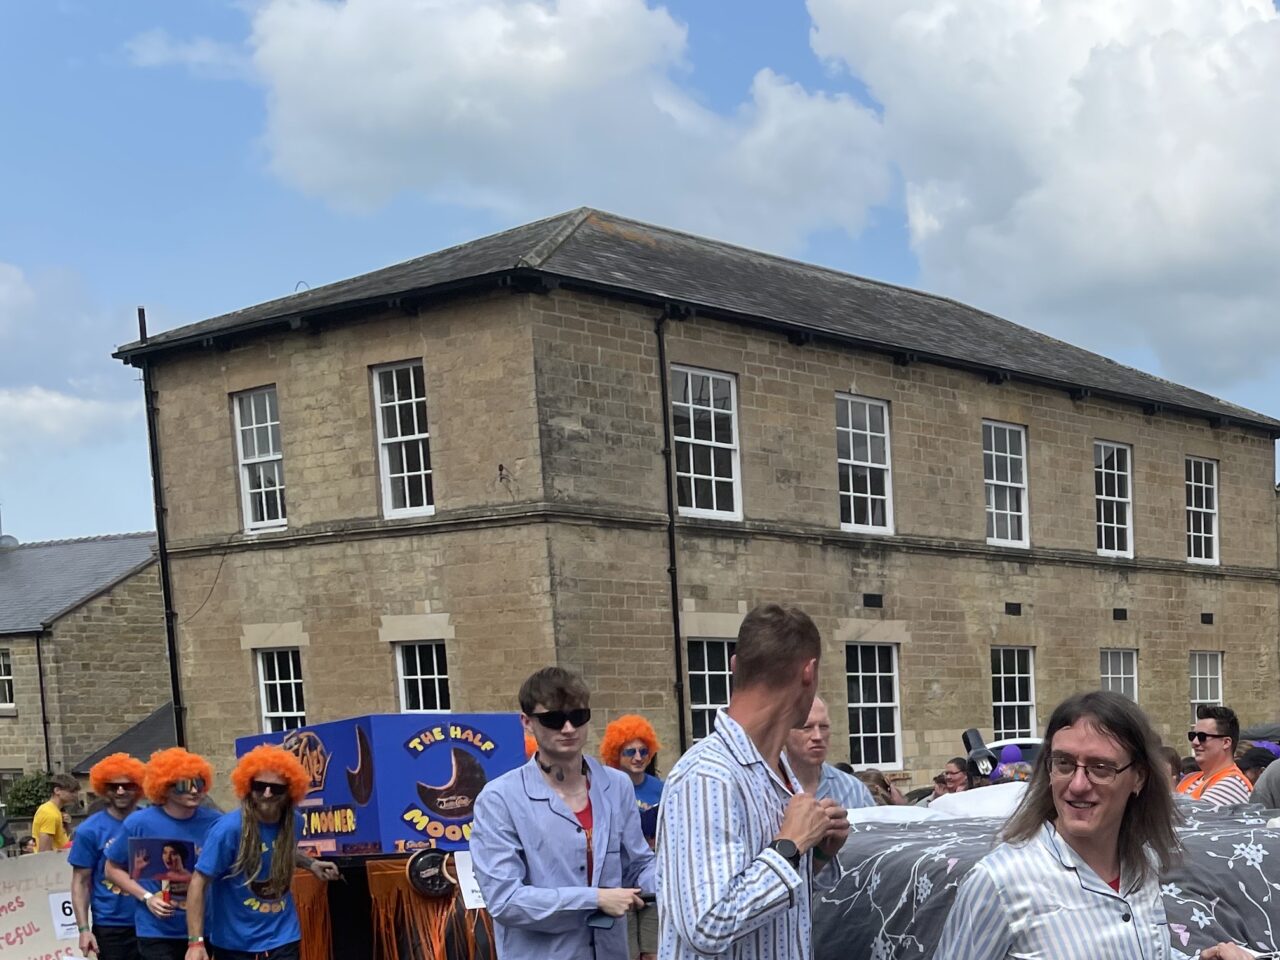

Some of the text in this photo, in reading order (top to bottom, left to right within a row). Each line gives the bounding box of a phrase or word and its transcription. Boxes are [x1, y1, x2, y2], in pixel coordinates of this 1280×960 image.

[408, 725, 495, 752] THE HALF
[310, 808, 356, 834] MOONER
[61, 900, 73, 917] 6
